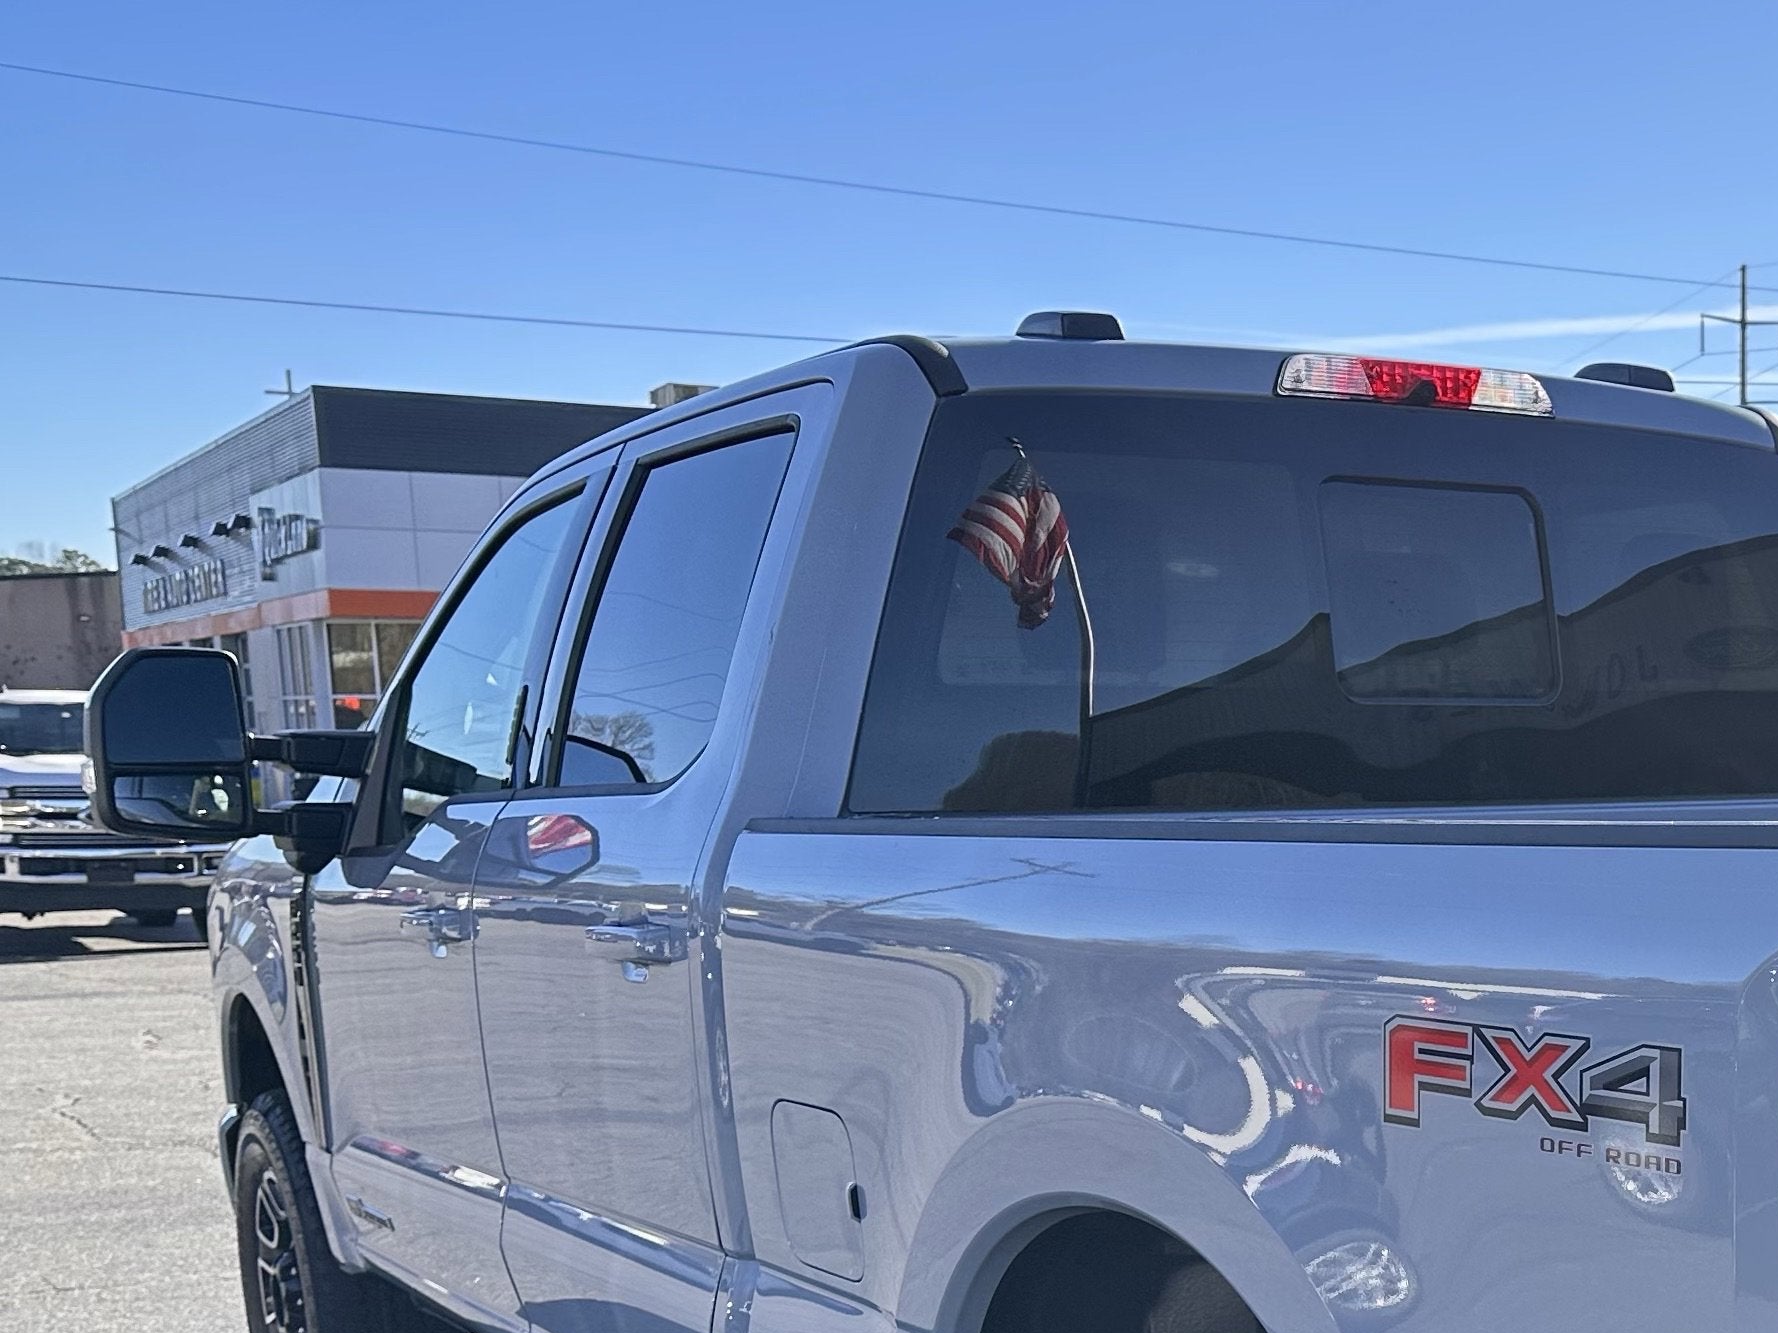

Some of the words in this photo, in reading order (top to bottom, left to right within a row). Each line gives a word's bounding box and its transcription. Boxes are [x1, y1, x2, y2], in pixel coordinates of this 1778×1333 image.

[1383, 1013, 1687, 1148] FX4
[1539, 1136, 1594, 1159] OFF
[1604, 1146, 1683, 1176] ROAD
